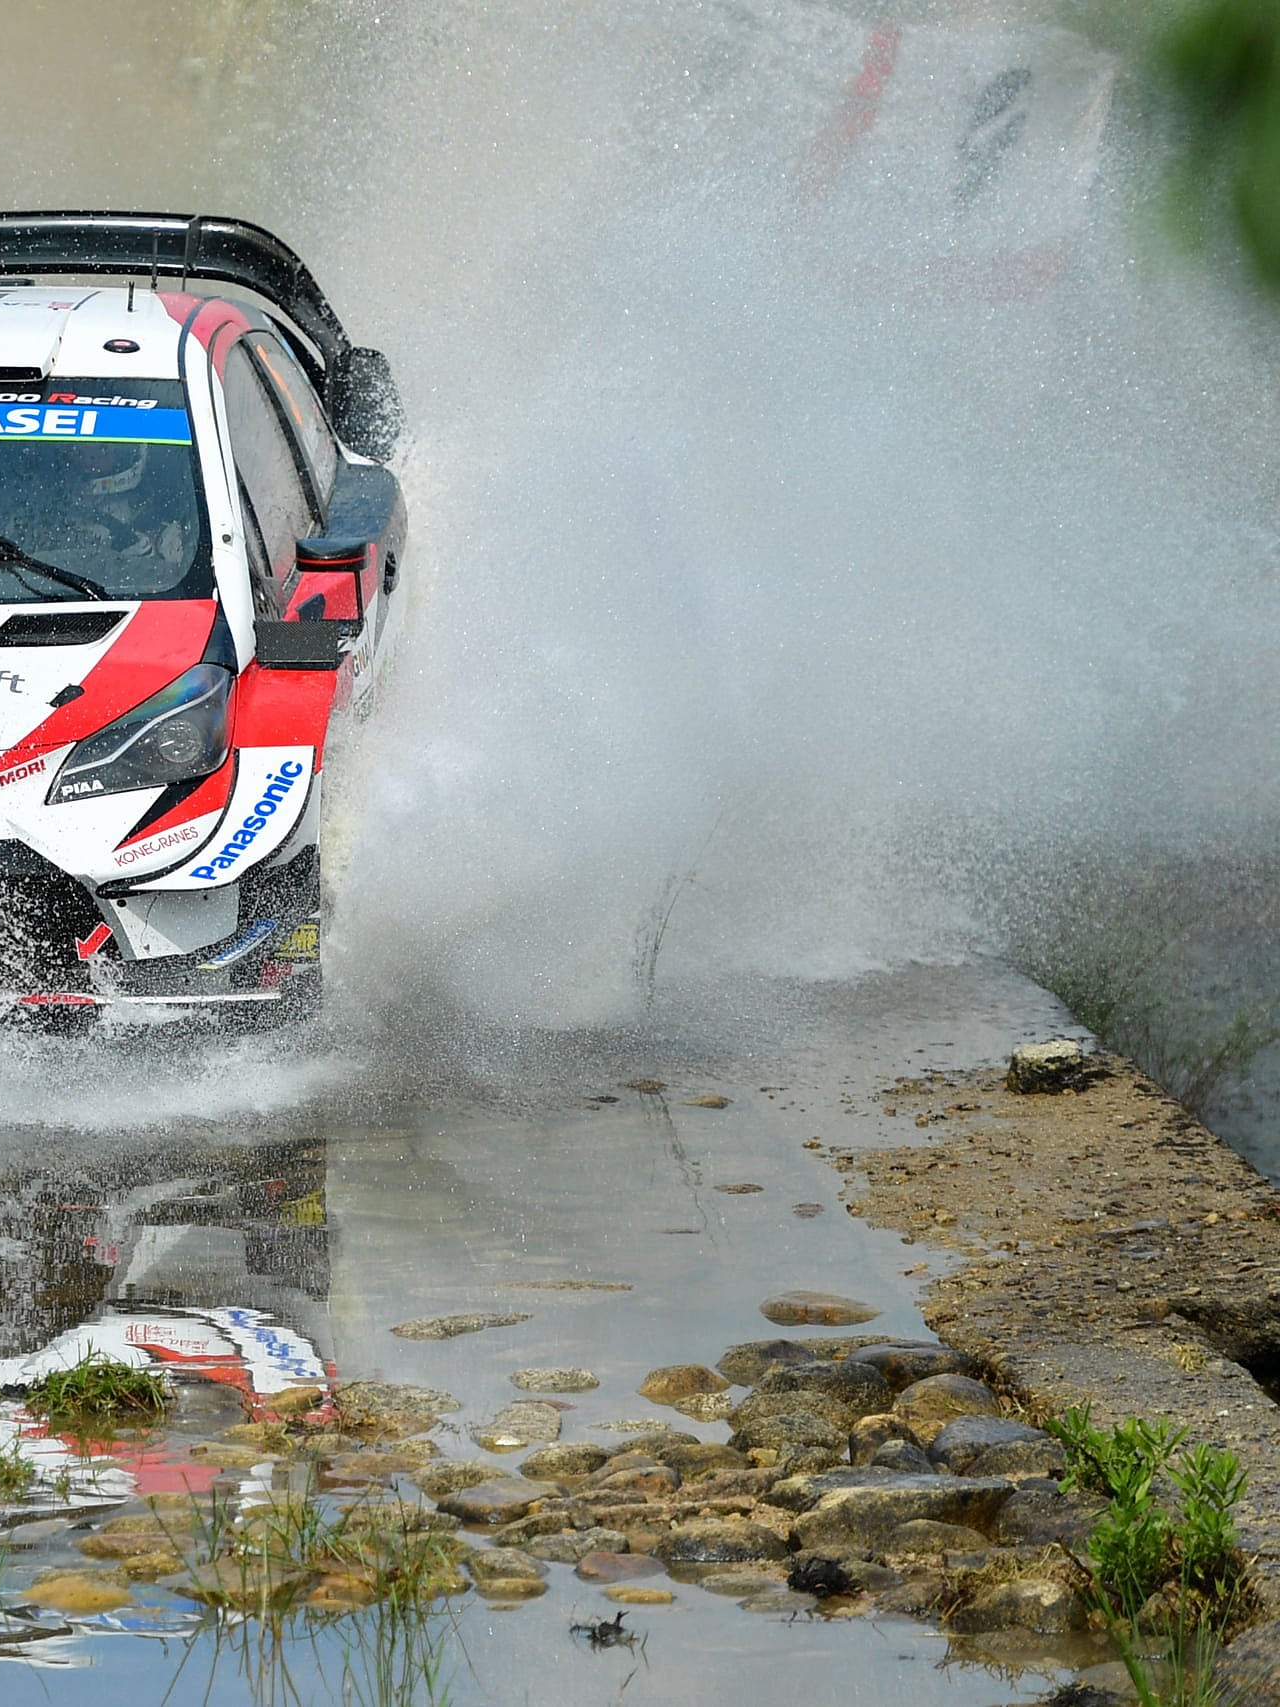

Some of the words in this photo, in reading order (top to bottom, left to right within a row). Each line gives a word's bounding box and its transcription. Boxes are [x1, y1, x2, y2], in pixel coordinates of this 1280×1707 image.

[48, 392, 158, 410] Racing
[60, 779, 105, 797] PIAA
[188, 760, 304, 881] Panasonic
[115, 826, 199, 868] KONECRANES
